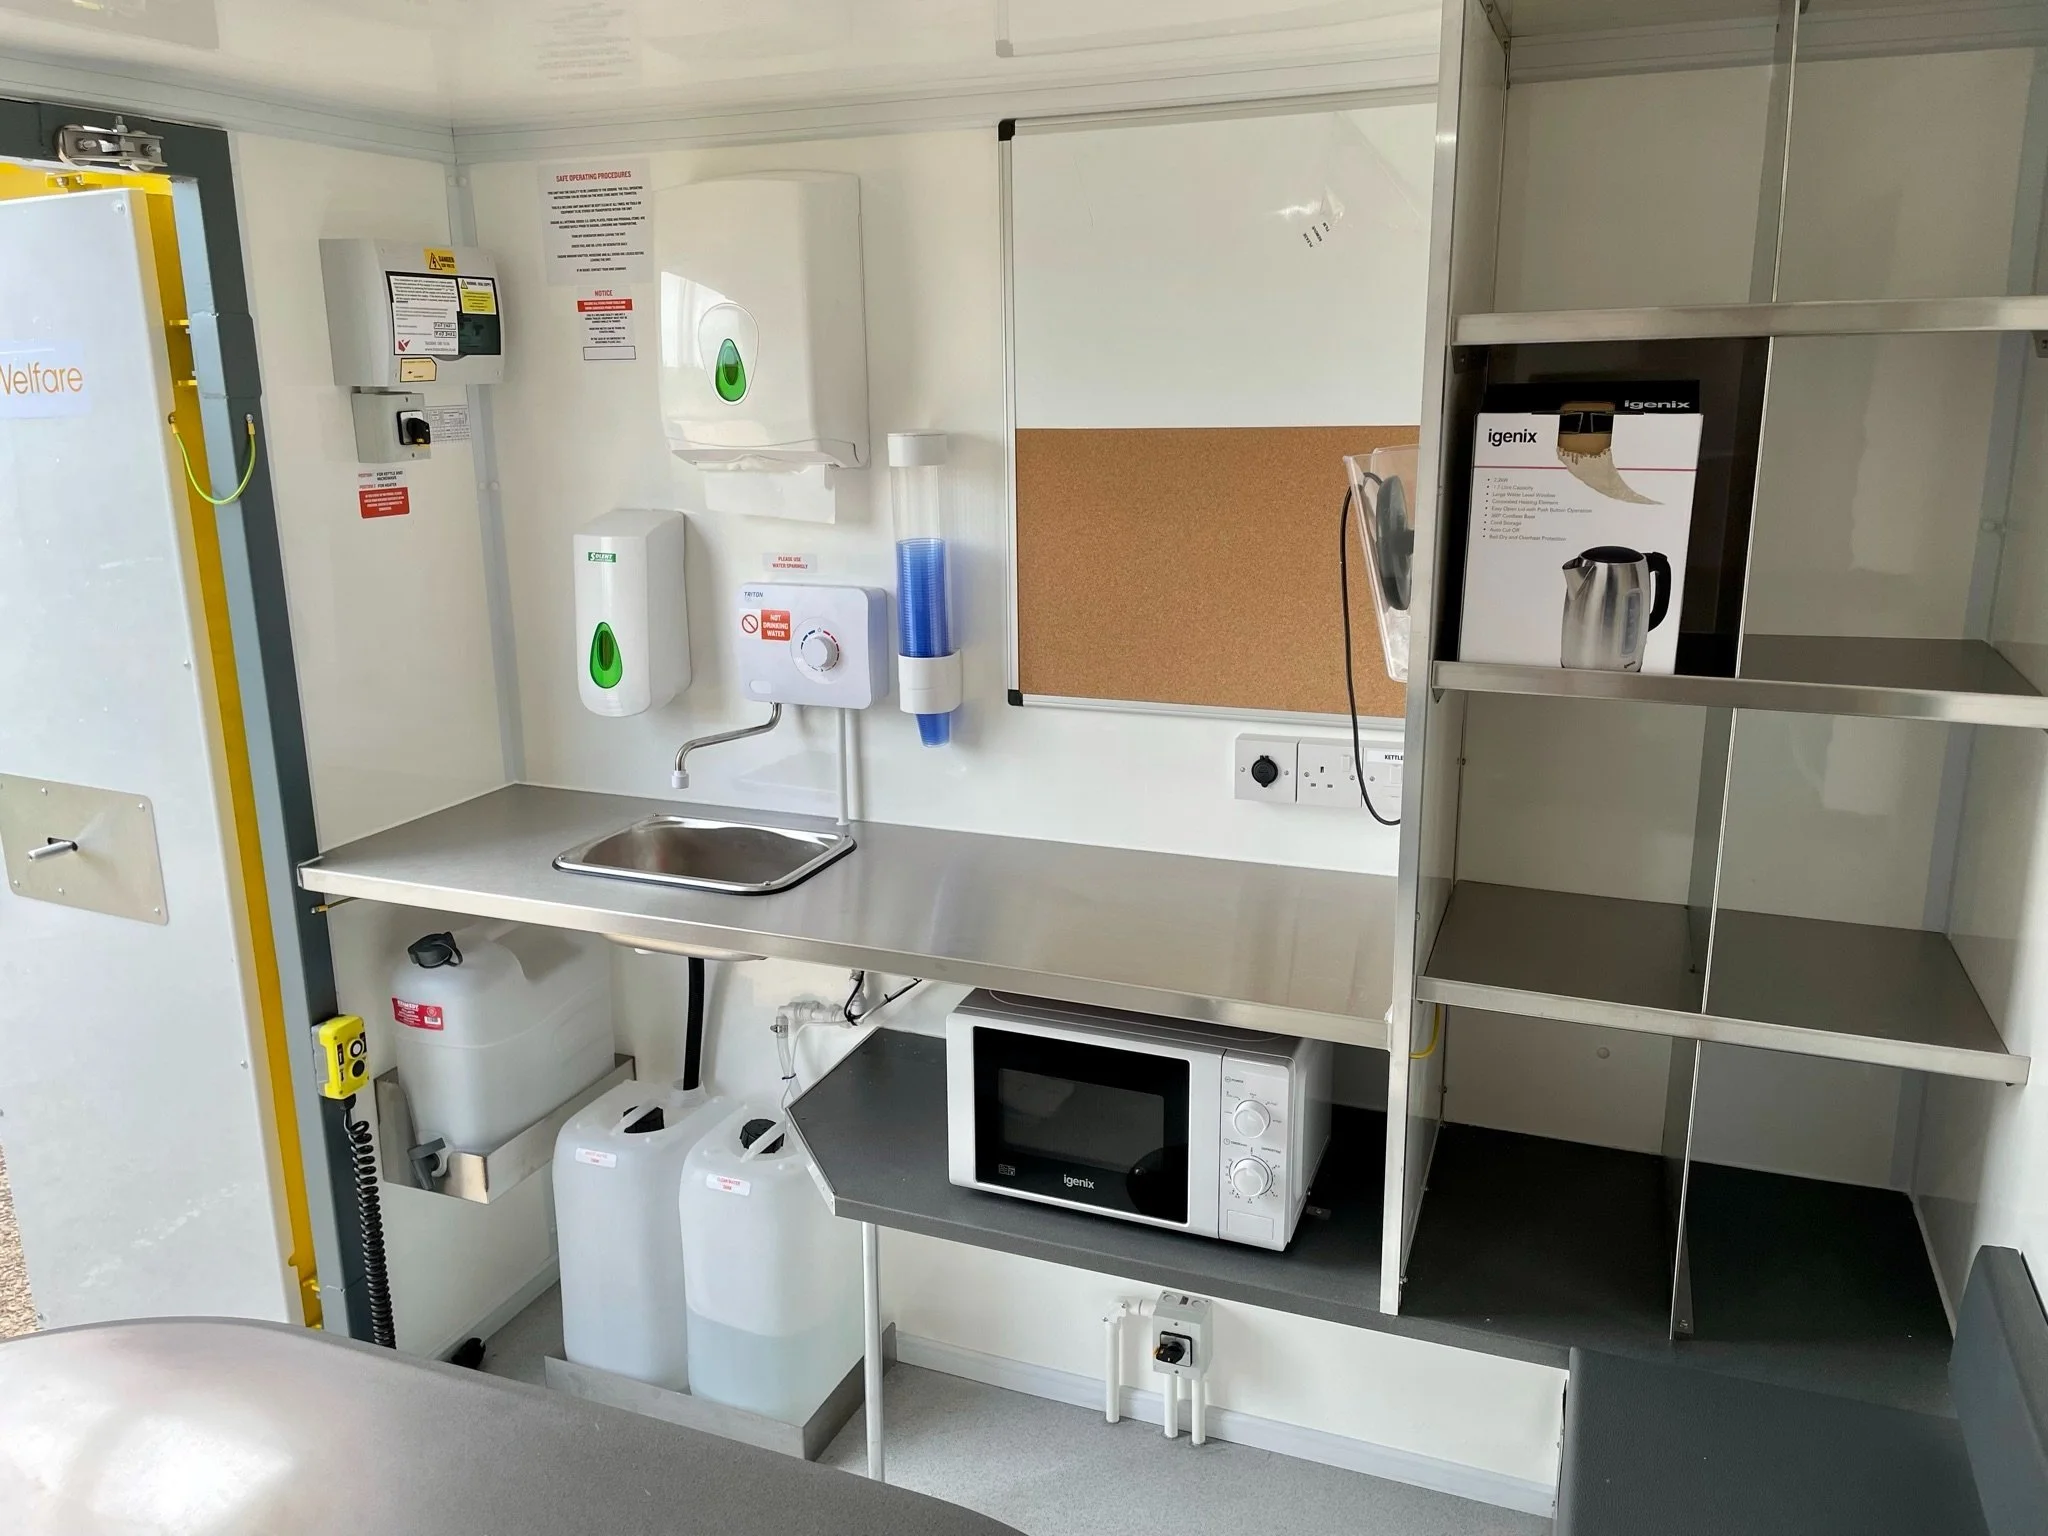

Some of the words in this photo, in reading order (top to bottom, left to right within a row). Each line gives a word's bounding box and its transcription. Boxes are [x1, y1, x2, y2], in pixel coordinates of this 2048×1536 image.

[569, 173, 597, 181] OPERATING
[598, 171, 631, 179] PROCEDURES
[1624, 400, 1690, 409] igenix
[1488, 428, 1537, 446] igenix
[1063, 1174, 1095, 1190] igenix
